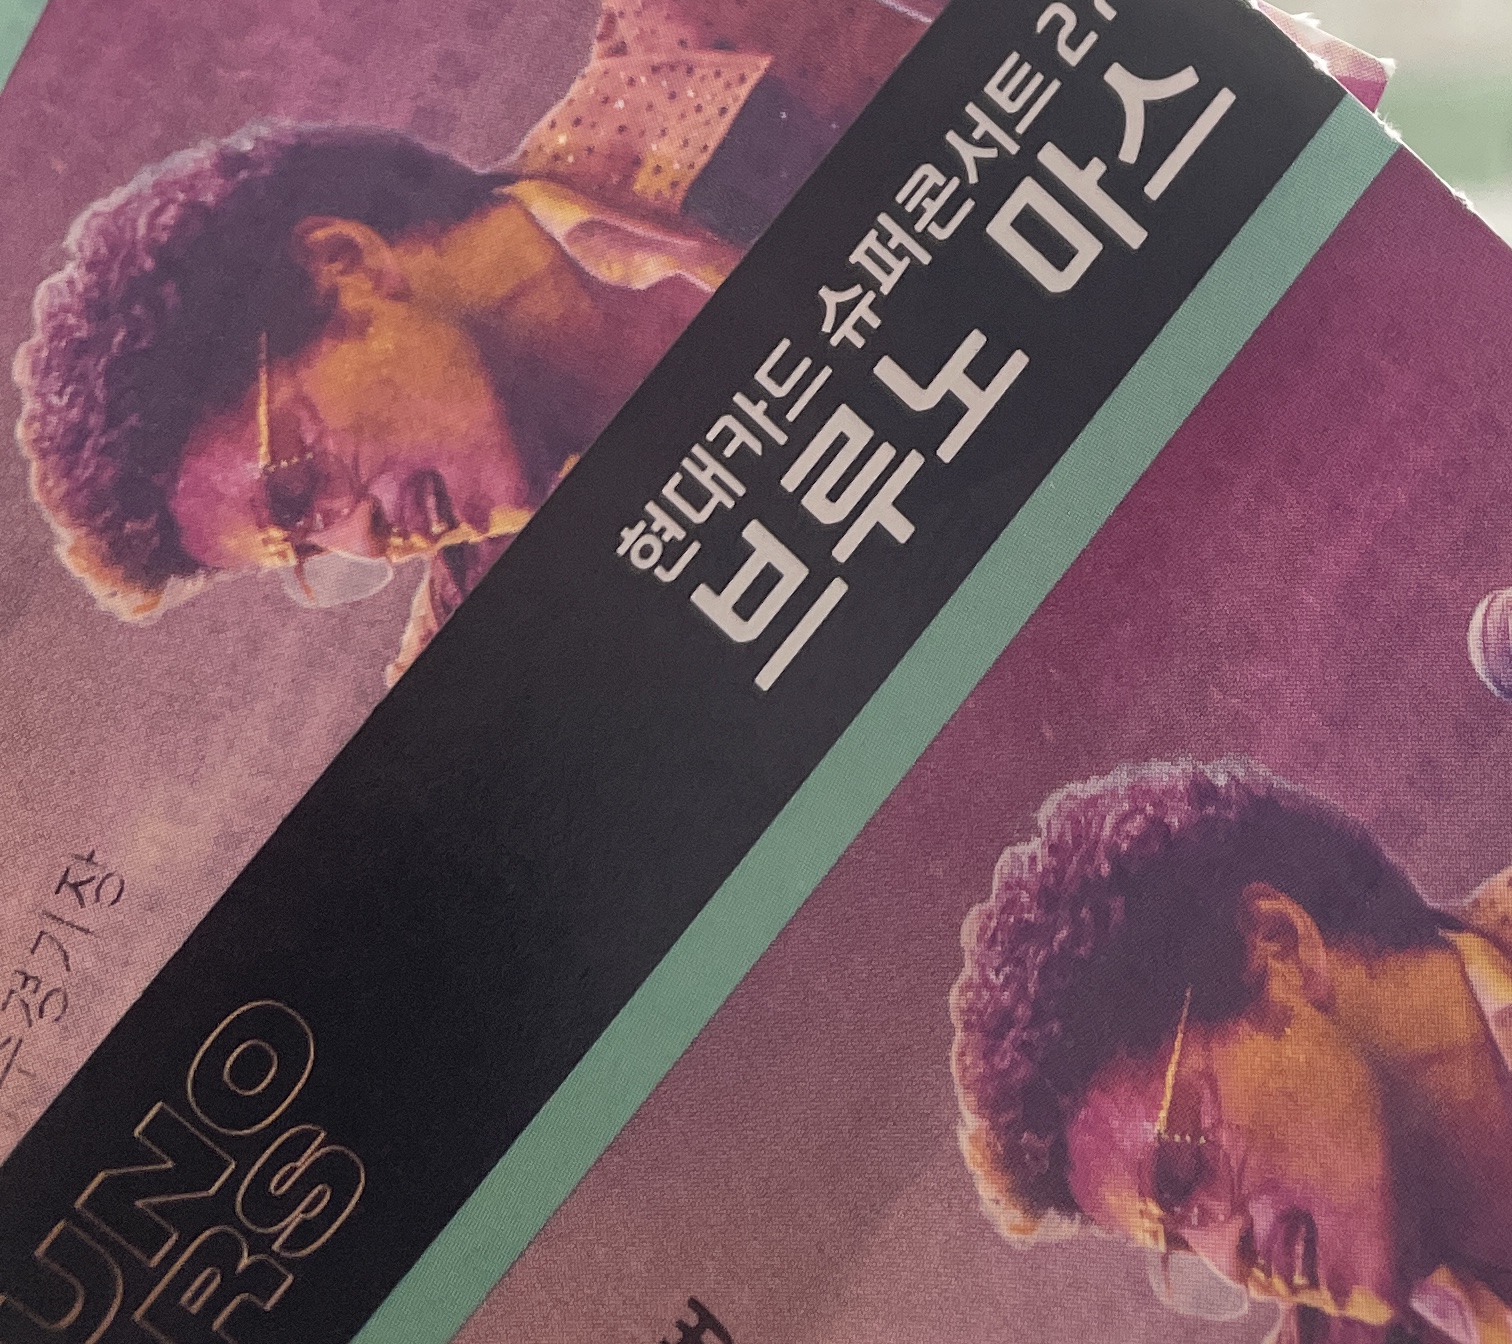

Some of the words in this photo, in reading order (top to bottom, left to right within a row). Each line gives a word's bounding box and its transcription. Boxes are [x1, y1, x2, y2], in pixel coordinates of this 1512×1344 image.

[614, 337, 834, 583] 현대카드
[817, 50, 1062, 349] 슈퍼콘서트
[689, 327, 1030, 692] 브루노
[984, 61, 1237, 294] 마스
